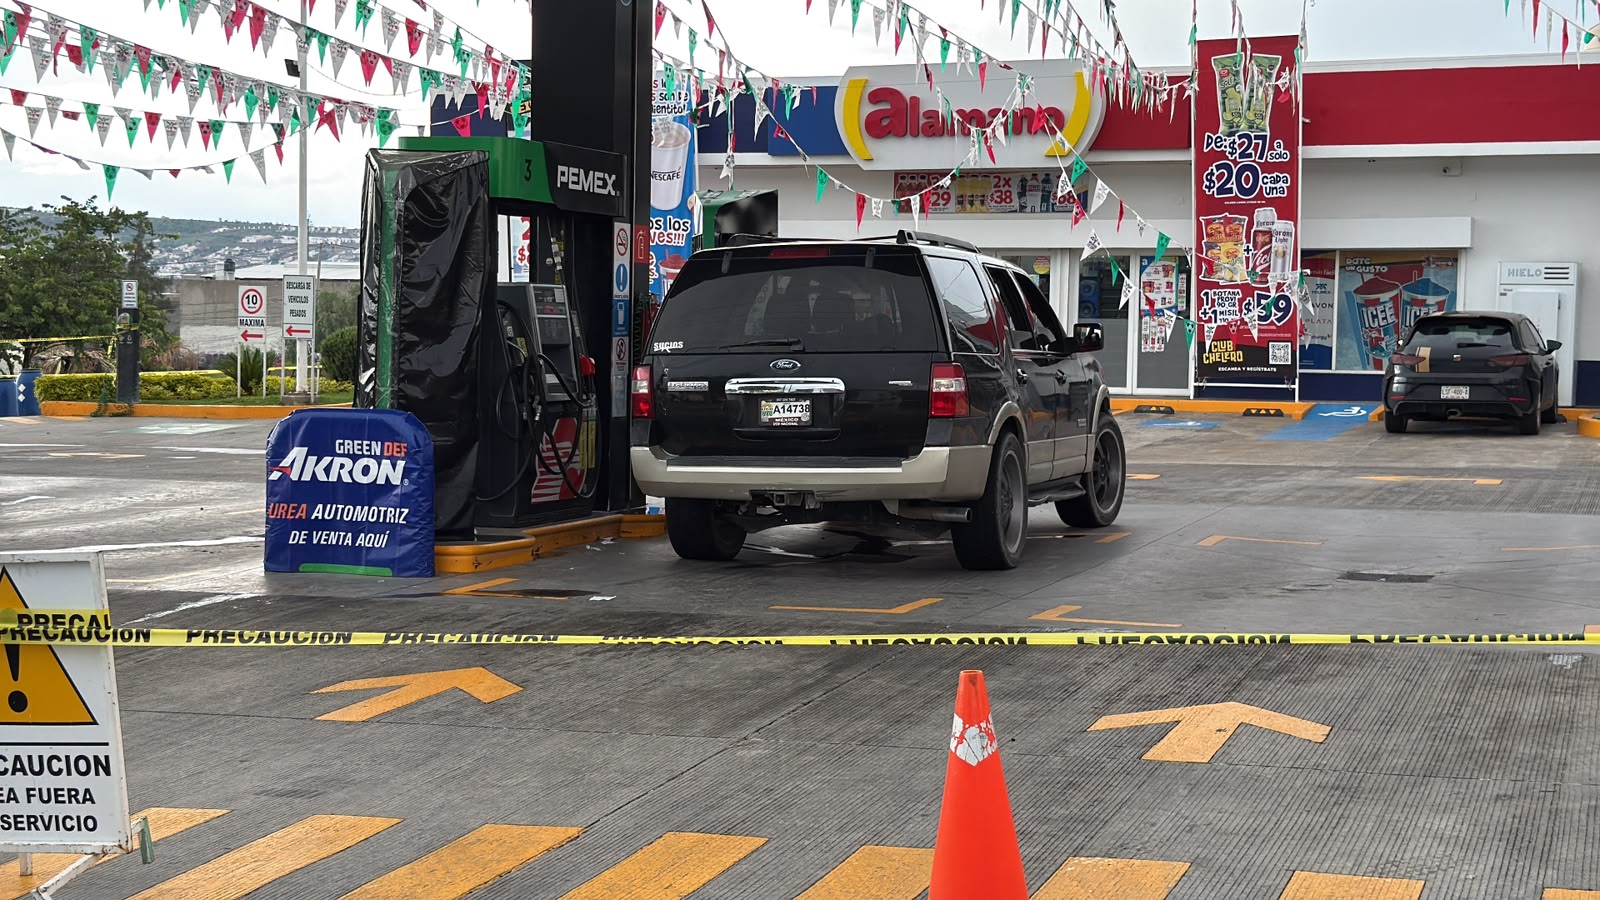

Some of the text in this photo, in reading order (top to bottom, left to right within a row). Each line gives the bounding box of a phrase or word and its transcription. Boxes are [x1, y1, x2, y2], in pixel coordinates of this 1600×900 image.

[1228, 133, 1268, 161] $27
[1269, 151, 1288, 160] solo
[524, 159, 532, 182] 3
[557, 165, 617, 197] PEMEX
[1205, 162, 1260, 197] $20
[990, 190, 1013, 204] $38
[669, 217, 689, 232] los
[1356, 265, 1388, 273] GUSTO
[1507, 268, 1542, 278] HIELO
[286, 282, 311, 290] DESCARGA DE
[245, 294, 258, 305] 10
[1203, 291, 1210, 306] 1
[289, 309, 307, 317] PESADOS
[1361, 302, 1397, 329] ICEE
[240, 319, 264, 327] MAXIMA
[1211, 341, 1234, 352] CLUB
[1203, 351, 1244, 363] CHELERO
[776, 361, 794, 369] Ford
[774, 404, 810, 414] A14738
[336, 439, 408, 457] GREEN DEF
[268, 446, 406, 486] AKRON
[268, 503, 409, 524] UREA AUTOMOTRIZ
[289, 530, 390, 548] DE VENTA AQUÍ
[26, 787, 96, 804] FUERA
[1, 814, 98, 832] SERVICIO
